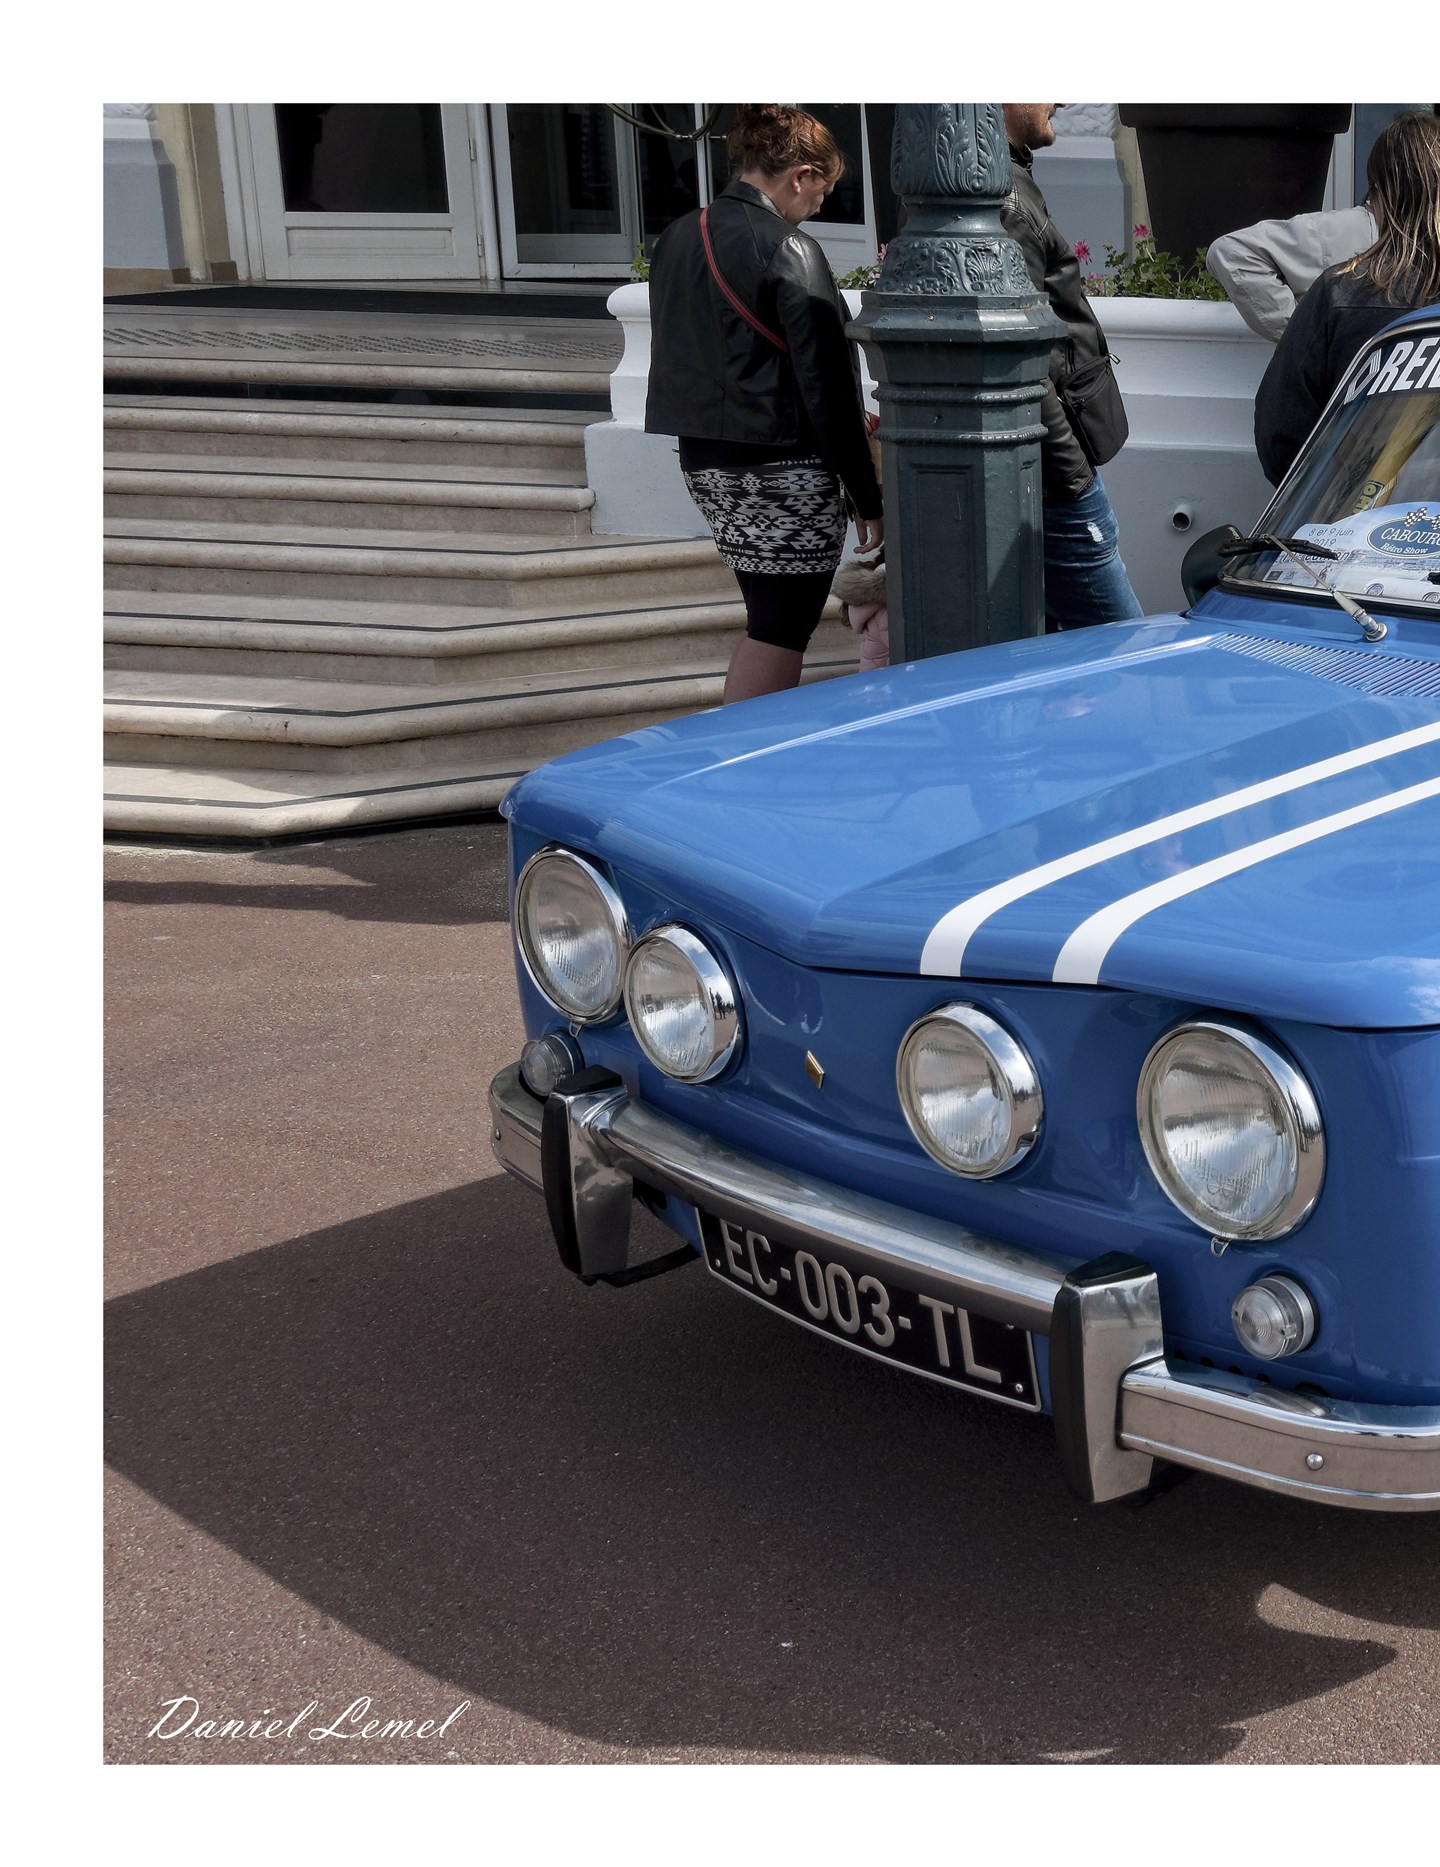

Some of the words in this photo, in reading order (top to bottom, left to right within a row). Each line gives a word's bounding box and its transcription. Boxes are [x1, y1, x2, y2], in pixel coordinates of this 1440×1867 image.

[1308, 528, 1316, 537] 8
[1317, 527, 1328, 537] et
[1329, 527, 1337, 537] 9
[1336, 527, 1354, 538] juin
[1380, 541, 1403, 554] Rétro
[1403, 545, 1428, 555] Show
[720, 1217, 1002, 1385] EC-003-TL
